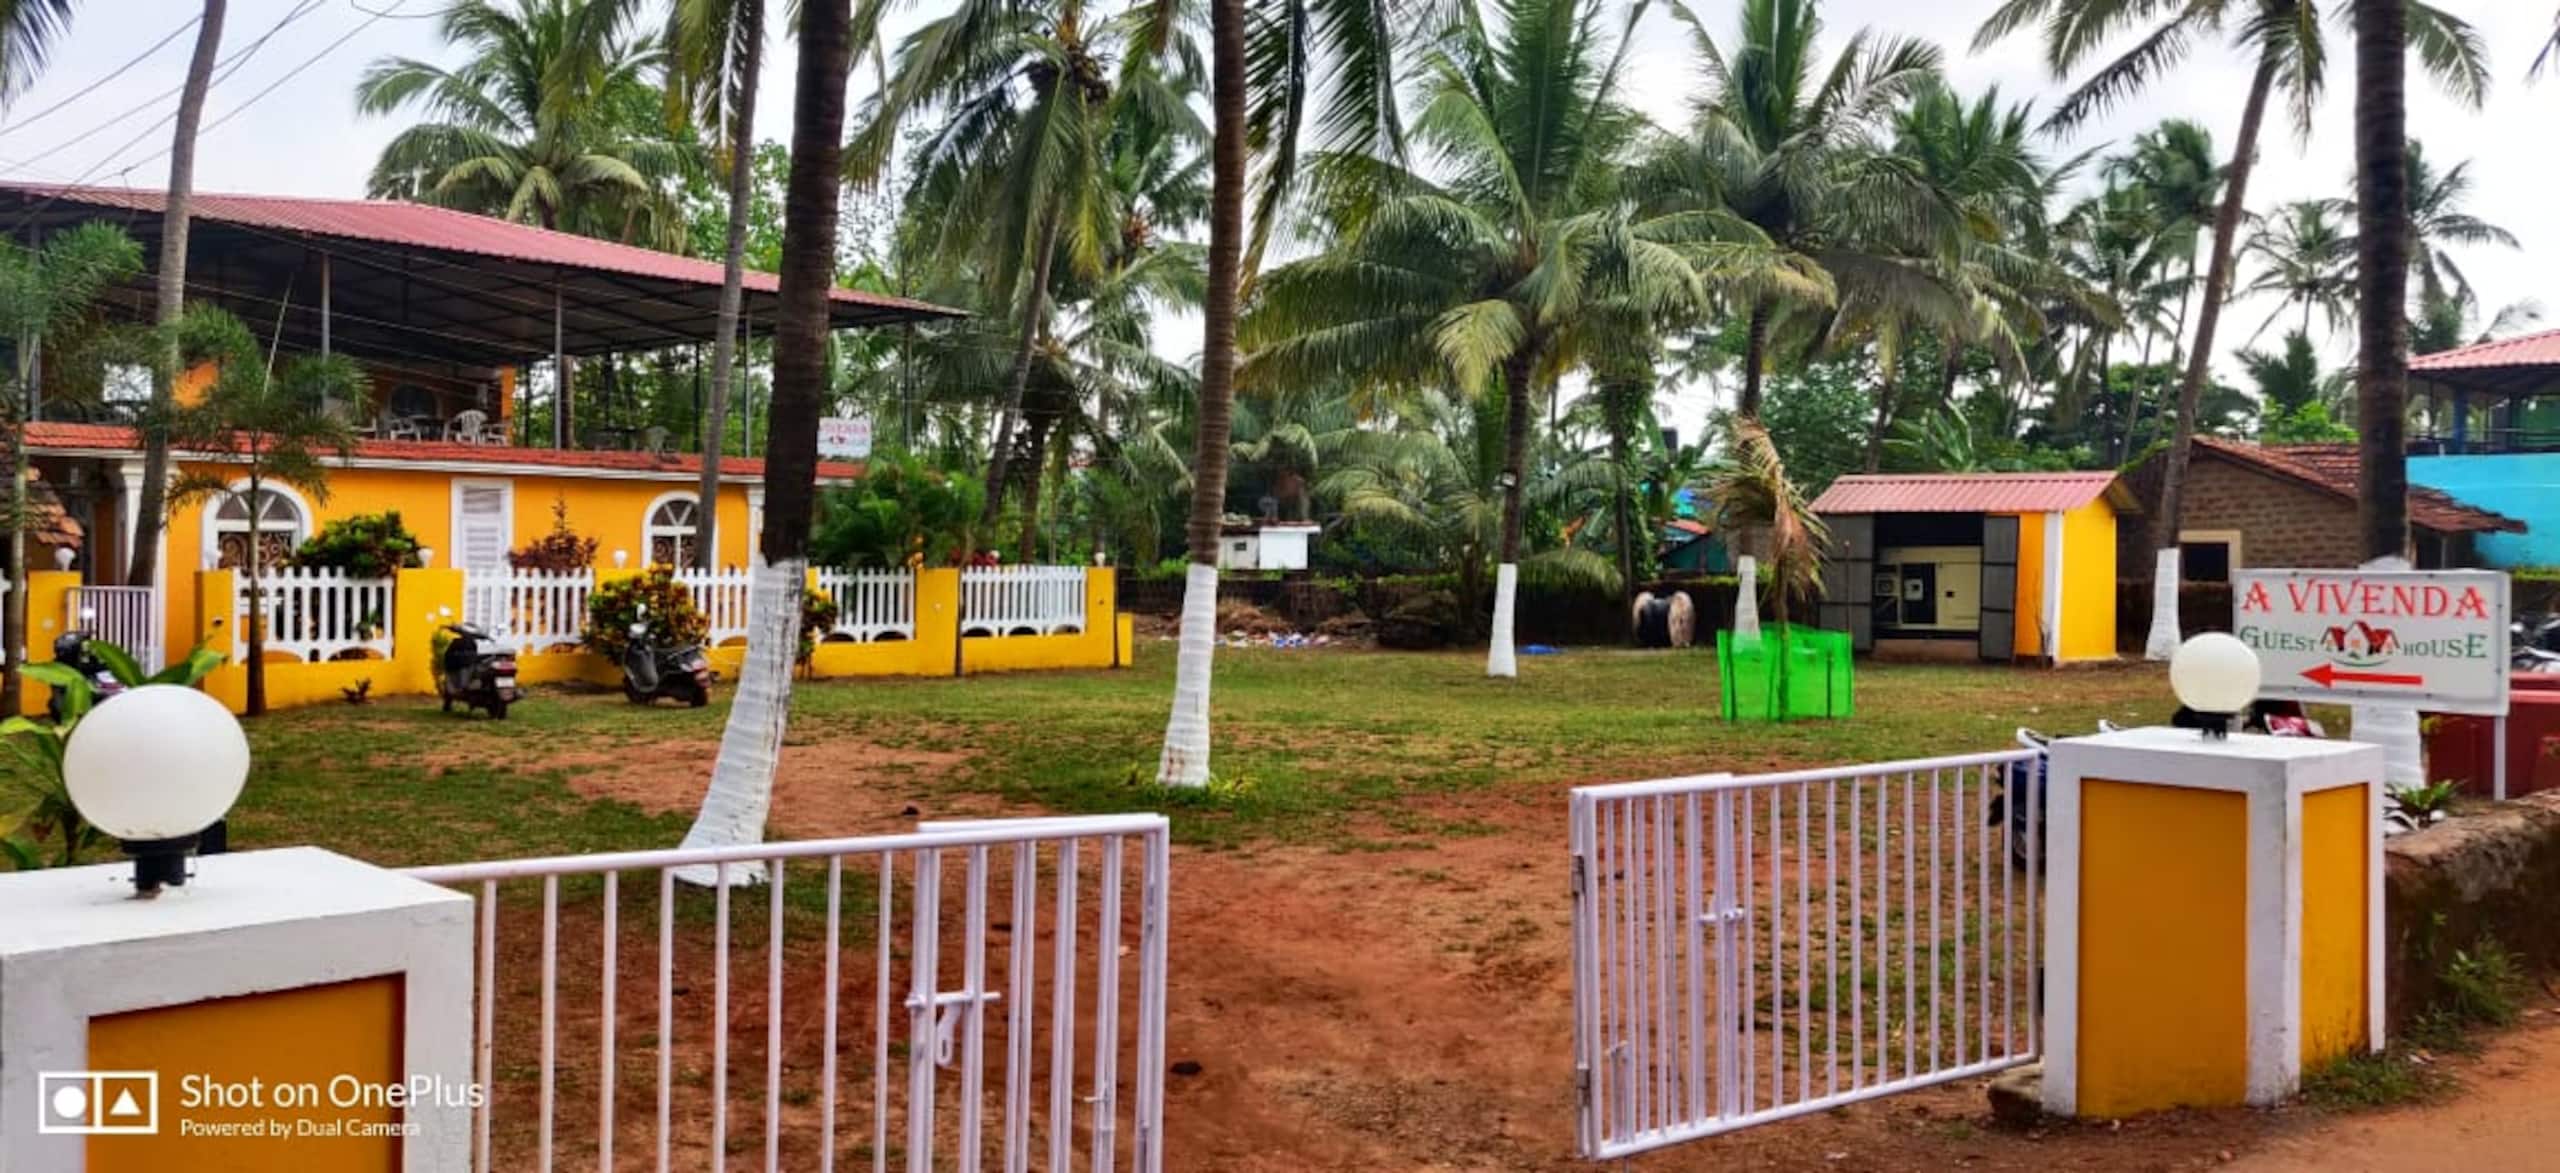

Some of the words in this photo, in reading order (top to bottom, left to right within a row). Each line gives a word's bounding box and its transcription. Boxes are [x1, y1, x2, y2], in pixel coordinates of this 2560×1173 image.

[2242, 580, 2271, 612] A
[2287, 577, 2488, 619] VIVENDA
[2239, 626, 2317, 651] GUEST
[2403, 633, 2488, 658] HOUSE
